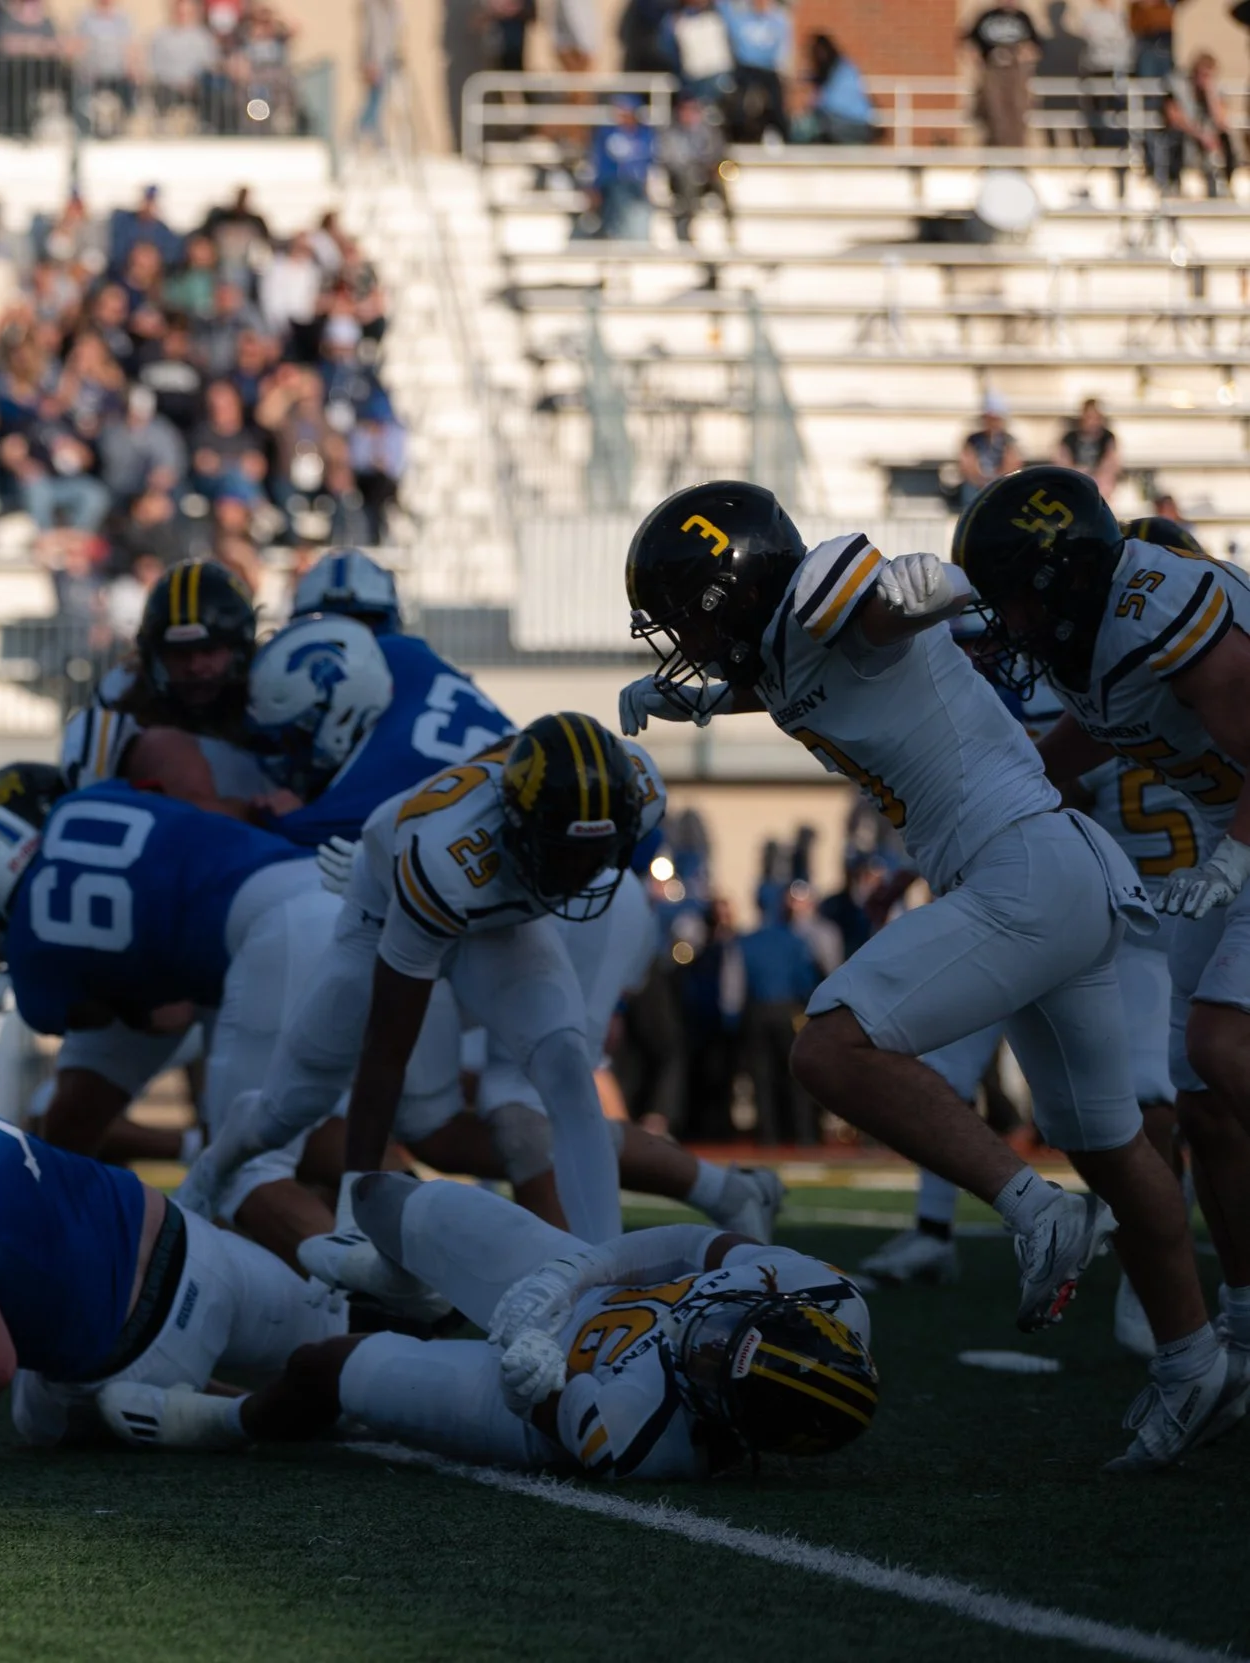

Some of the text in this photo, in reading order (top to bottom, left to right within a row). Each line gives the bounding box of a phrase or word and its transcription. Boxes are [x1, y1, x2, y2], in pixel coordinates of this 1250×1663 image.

[680, 514, 730, 557] 3
[1114, 569, 1165, 620] 55
[31, 801, 154, 952] 60
[446, 828, 500, 888] 29
